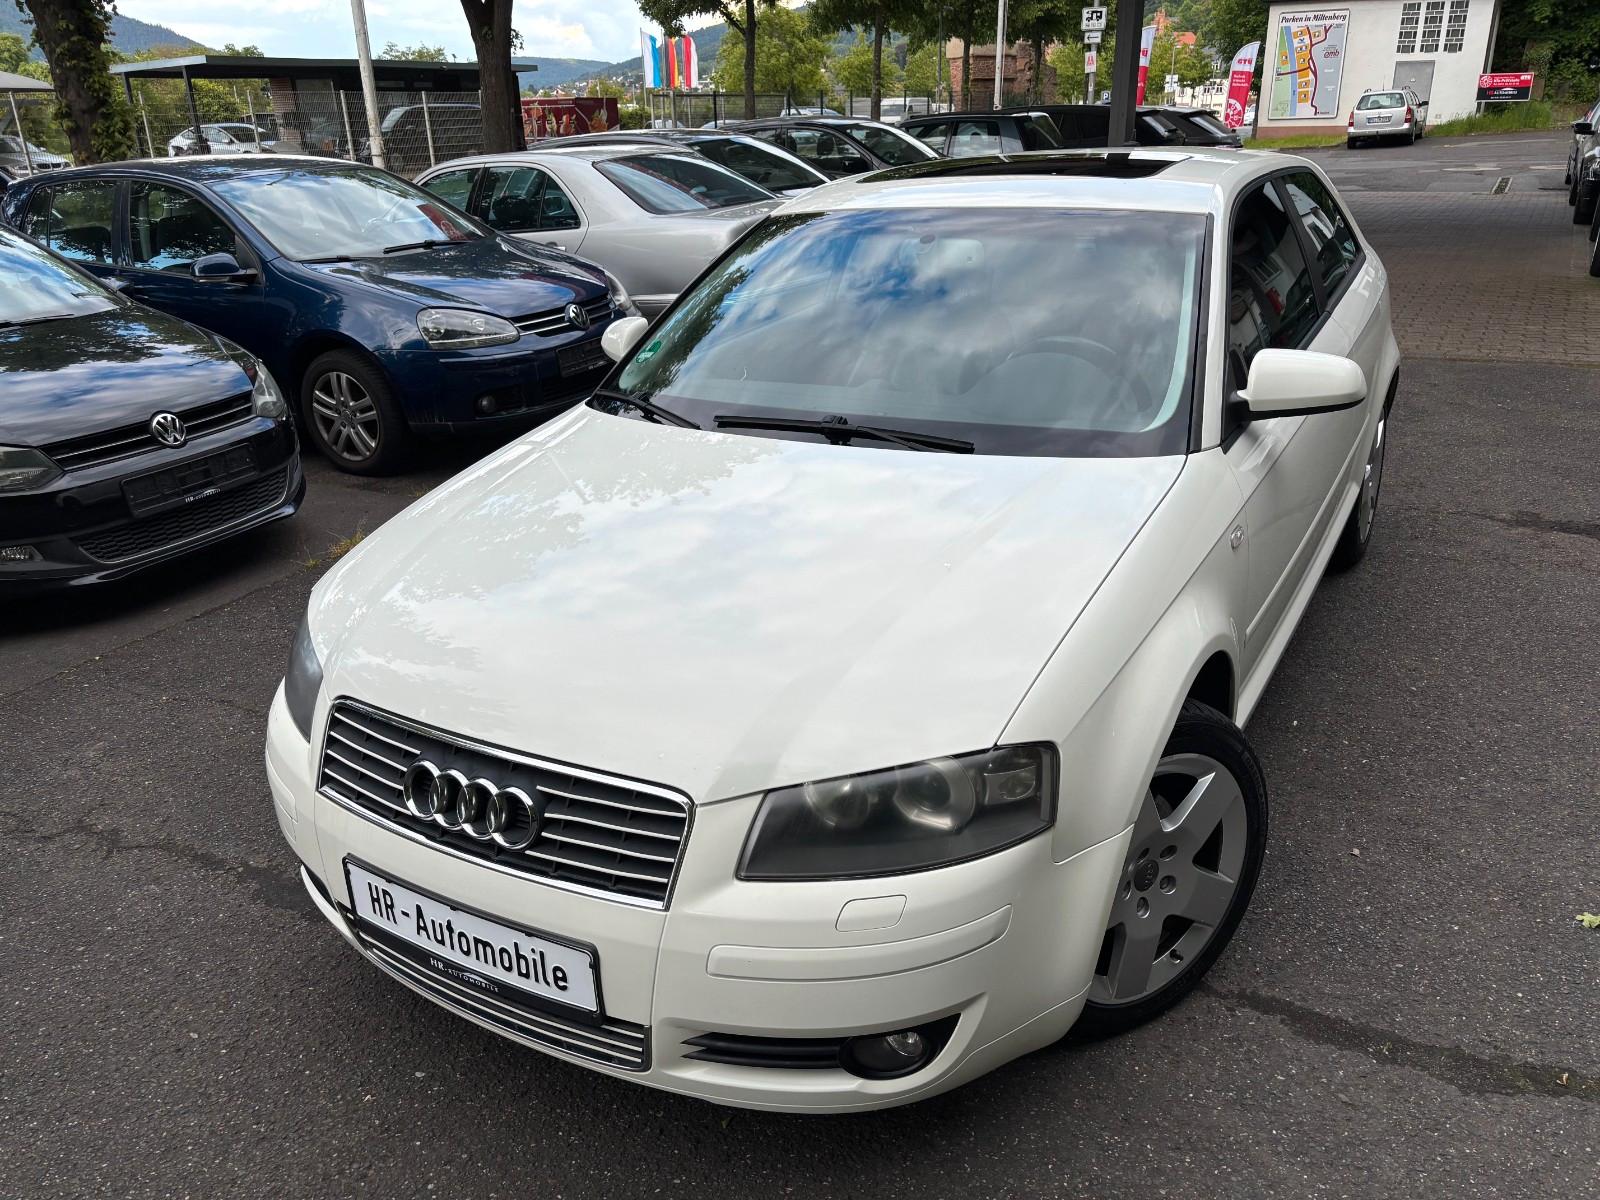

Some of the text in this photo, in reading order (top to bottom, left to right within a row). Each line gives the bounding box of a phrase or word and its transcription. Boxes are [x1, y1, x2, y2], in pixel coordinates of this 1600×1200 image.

[1281, 13, 1347, 24] Parken in Miltenberg
[367, 881, 569, 992] HR-Automobile
